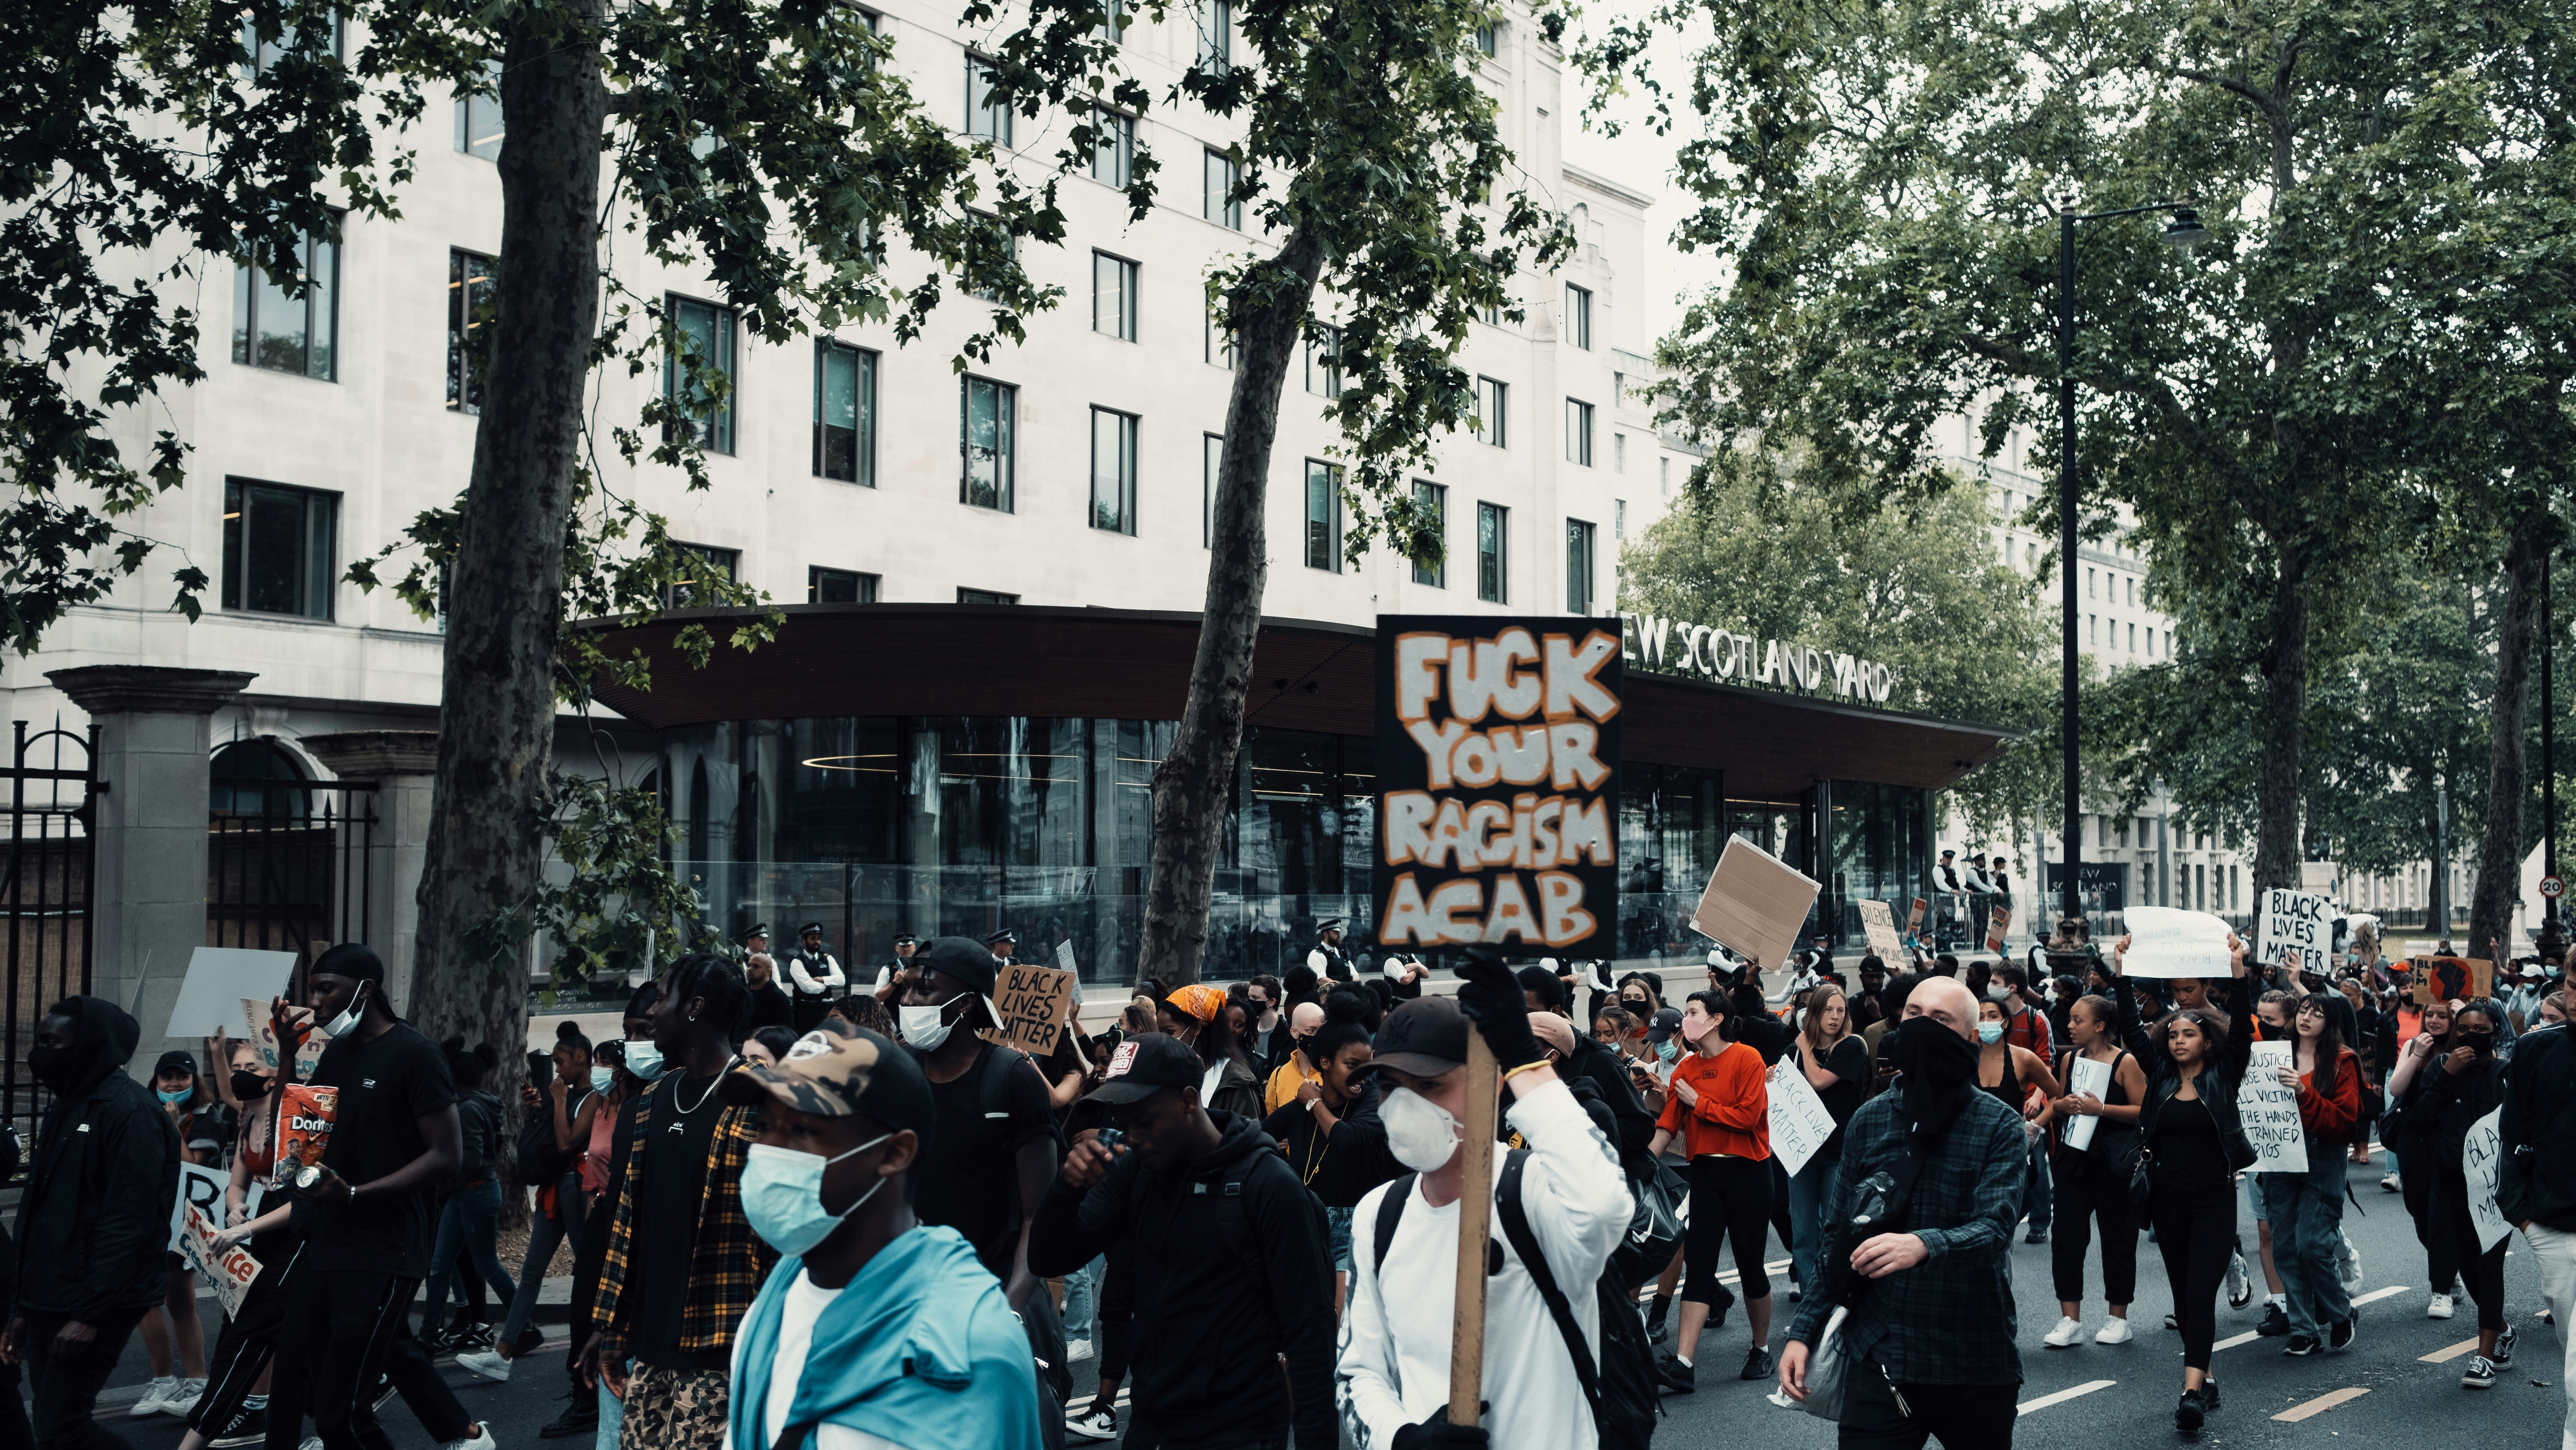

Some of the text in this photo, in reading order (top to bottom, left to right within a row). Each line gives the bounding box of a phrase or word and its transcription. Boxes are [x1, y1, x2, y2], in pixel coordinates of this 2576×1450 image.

[1601, 607, 1890, 701] EW SCOTLAND YARD
[1395, 625, 1622, 724] FUCK
[1404, 718, 1612, 791] YOUR
[2080, 869, 2100, 879] EW
[2543, 882, 2560, 891] 20
[1379, 870, 1598, 948] ACAB
[1861, 905, 1893, 927] SILENCE
[2272, 891, 2322, 923] BLACK
[2142, 929, 2180, 938] MATTER
[2273, 917, 2314, 944] LIVES
[1058, 943, 1071, 961] BLACK
[2179, 954, 2211, 964] BLACK
[1008, 969, 1067, 994] BLACK
[1001, 992, 1057, 1021] LIVES
[1650, 1016, 1658, 1027] NY
[1775, 1065, 1828, 1144] BLACK LIVES
[292, 1116, 334, 1133] Doritos
[2240, 1109, 2298, 1126] THE HANDS
[1768, 1102, 1807, 1163] MATTER
[2249, 1125, 2299, 1144] TRAINED
